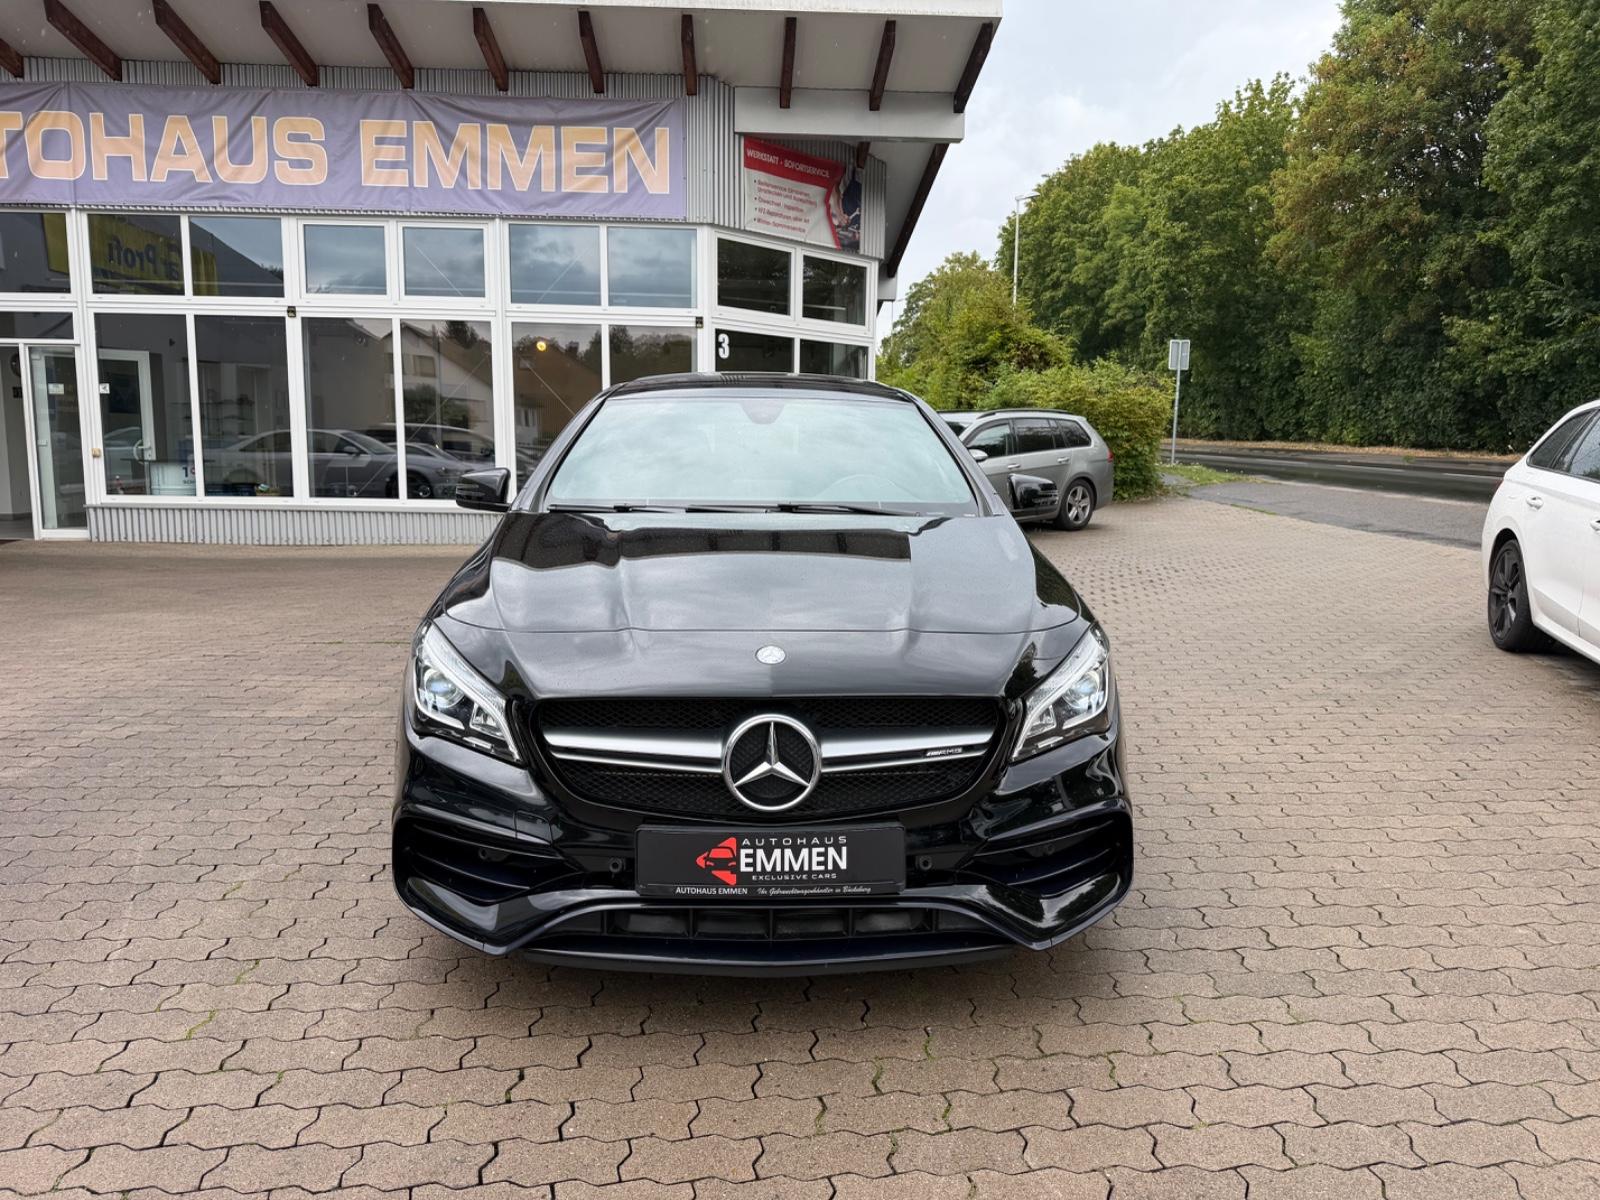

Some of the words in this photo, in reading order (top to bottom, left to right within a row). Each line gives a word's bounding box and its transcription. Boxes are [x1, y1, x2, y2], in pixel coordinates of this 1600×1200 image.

[360, 119, 670, 194] EMMEN
[746, 149, 779, 165] WERKSTATT
[718, 333, 730, 359] 3
[742, 835, 847, 846] AUTOHAUS
[740, 846, 847, 872] EMMEN
[675, 886, 717, 895] AUTOHAUS
[718, 887, 748, 895] EMMEN
